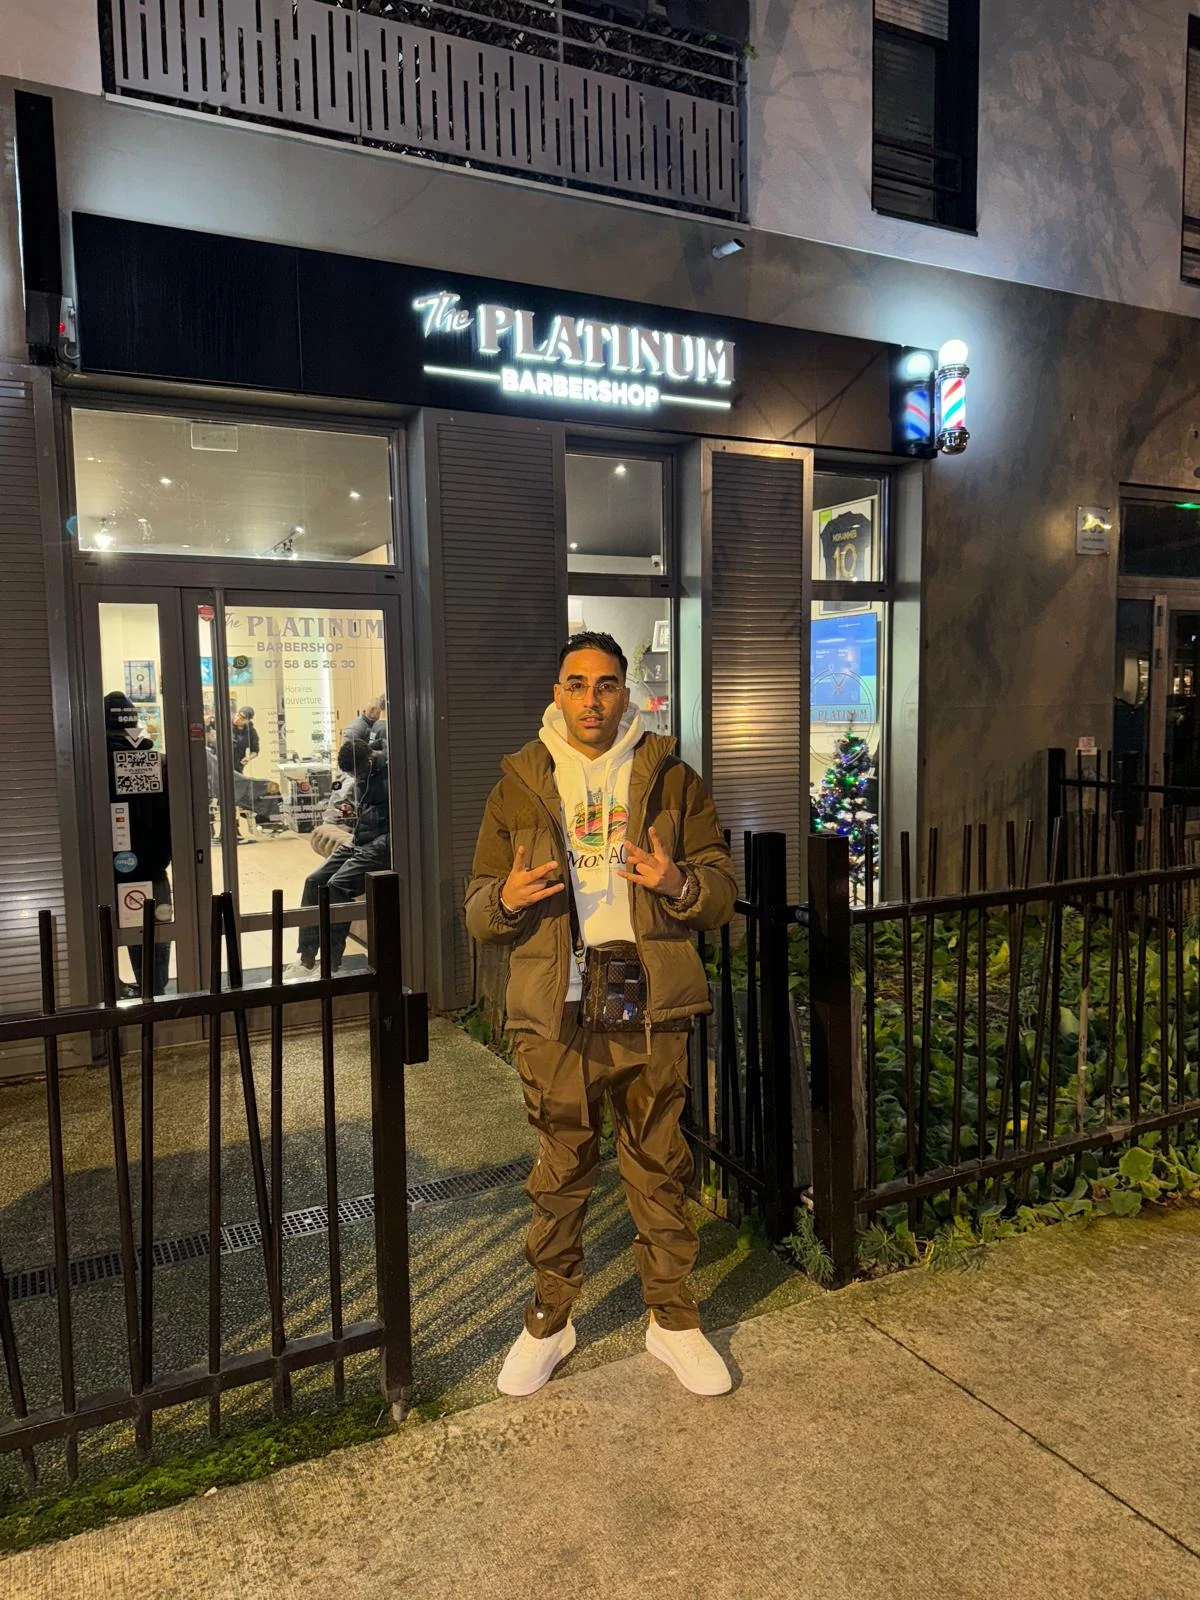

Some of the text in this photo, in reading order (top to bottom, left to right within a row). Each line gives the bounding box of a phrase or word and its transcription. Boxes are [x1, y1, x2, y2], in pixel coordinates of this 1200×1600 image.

[412, 291, 736, 385] The PLATINUM
[501, 368, 659, 407] BARBERSHOP
[832, 543, 858, 580] 10
[247, 615, 385, 639] PLATINUM
[257, 641, 343, 653] BARBERSHOP
[264, 659, 356, 669] 07 58 85 26 30
